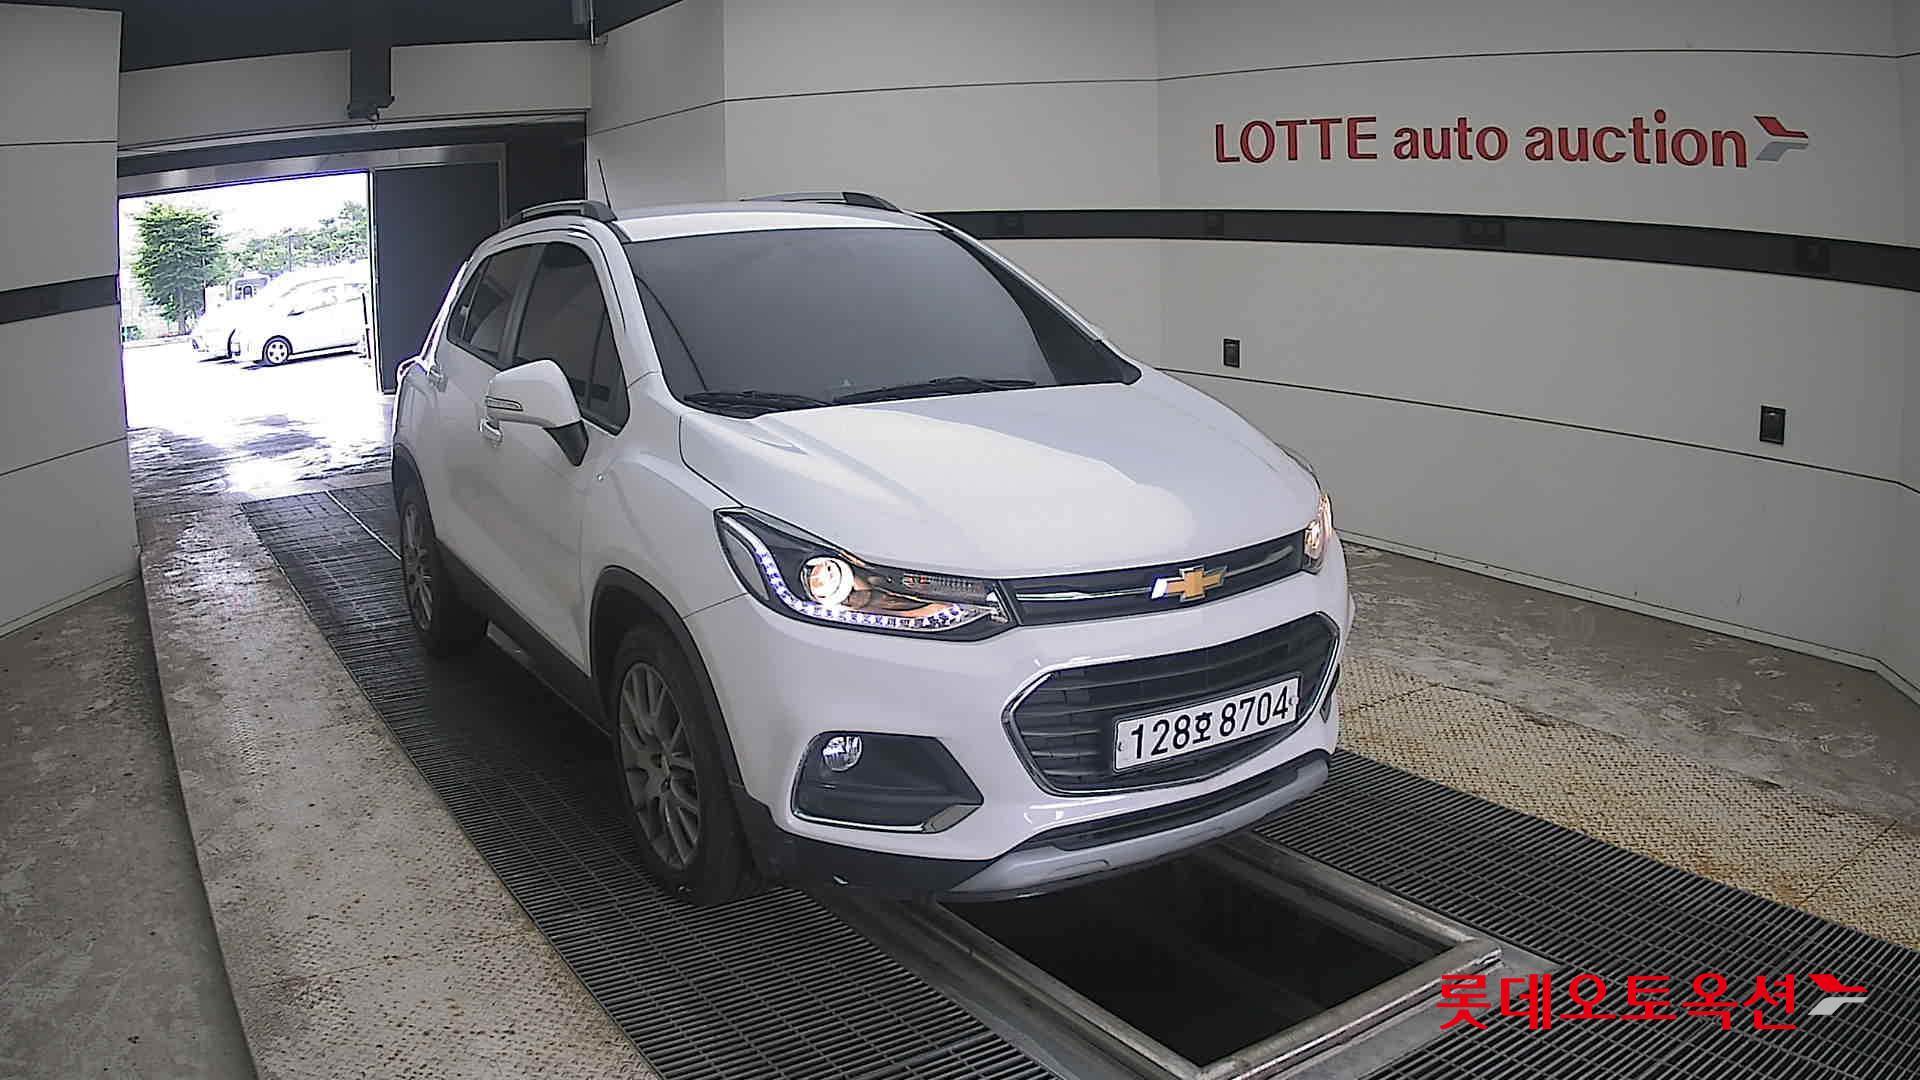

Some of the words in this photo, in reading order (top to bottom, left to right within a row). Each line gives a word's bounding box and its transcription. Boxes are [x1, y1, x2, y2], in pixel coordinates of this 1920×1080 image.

[1214, 117, 1379, 163] LOTTE
[1393, 116, 1509, 161] auto
[1524, 110, 1749, 168] auction
[1219, 685, 1289, 737] 8704
